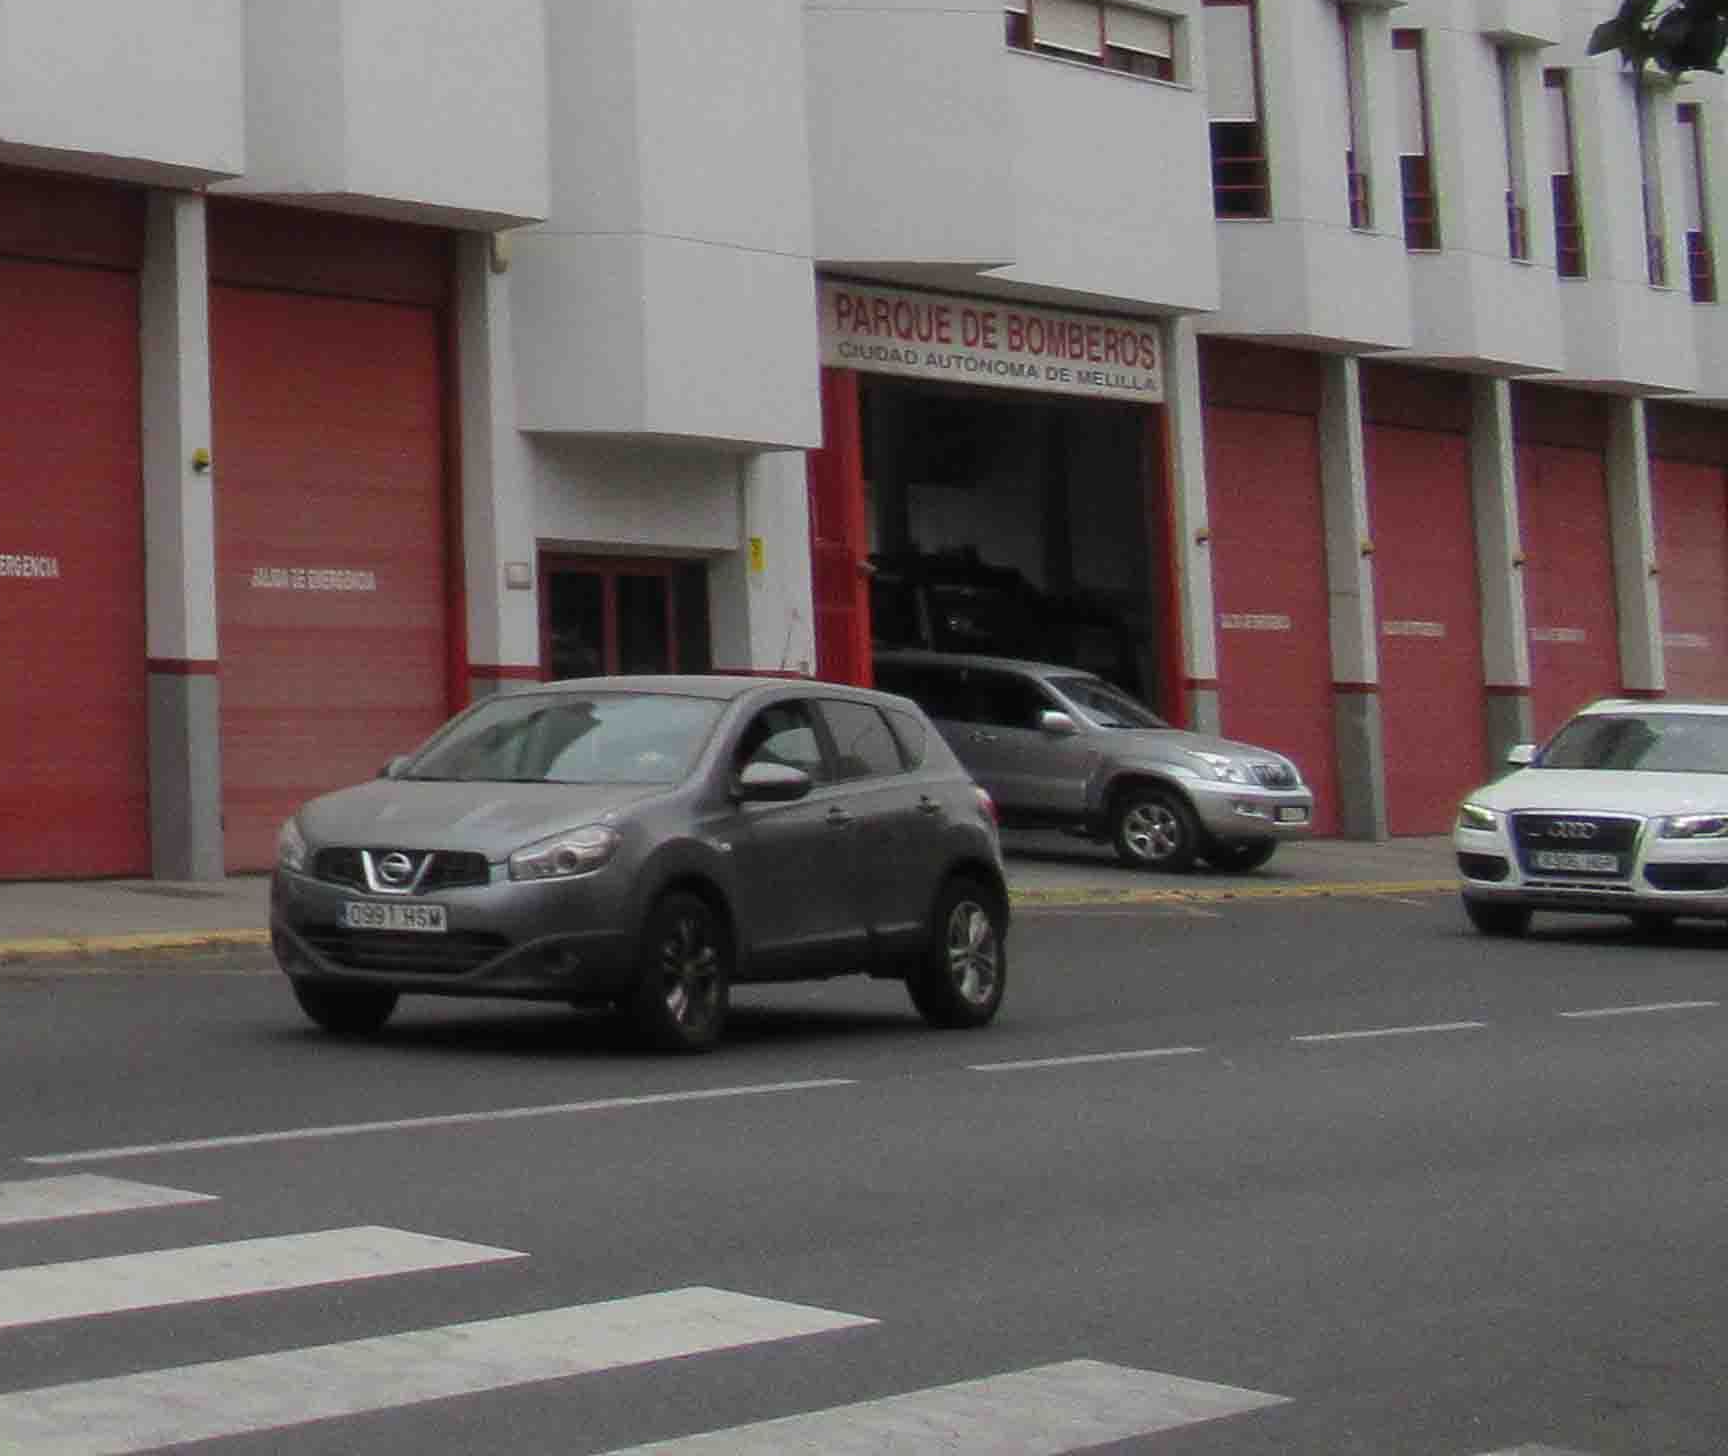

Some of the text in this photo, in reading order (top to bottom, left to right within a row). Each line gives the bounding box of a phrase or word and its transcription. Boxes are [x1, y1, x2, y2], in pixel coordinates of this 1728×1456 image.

[834, 292, 1155, 371] PARQUE DE BOMBEROS
[838, 342, 918, 365] CIUDAD
[1045, 365, 1073, 382] DE
[1076, 368, 1157, 391] MELILLA
